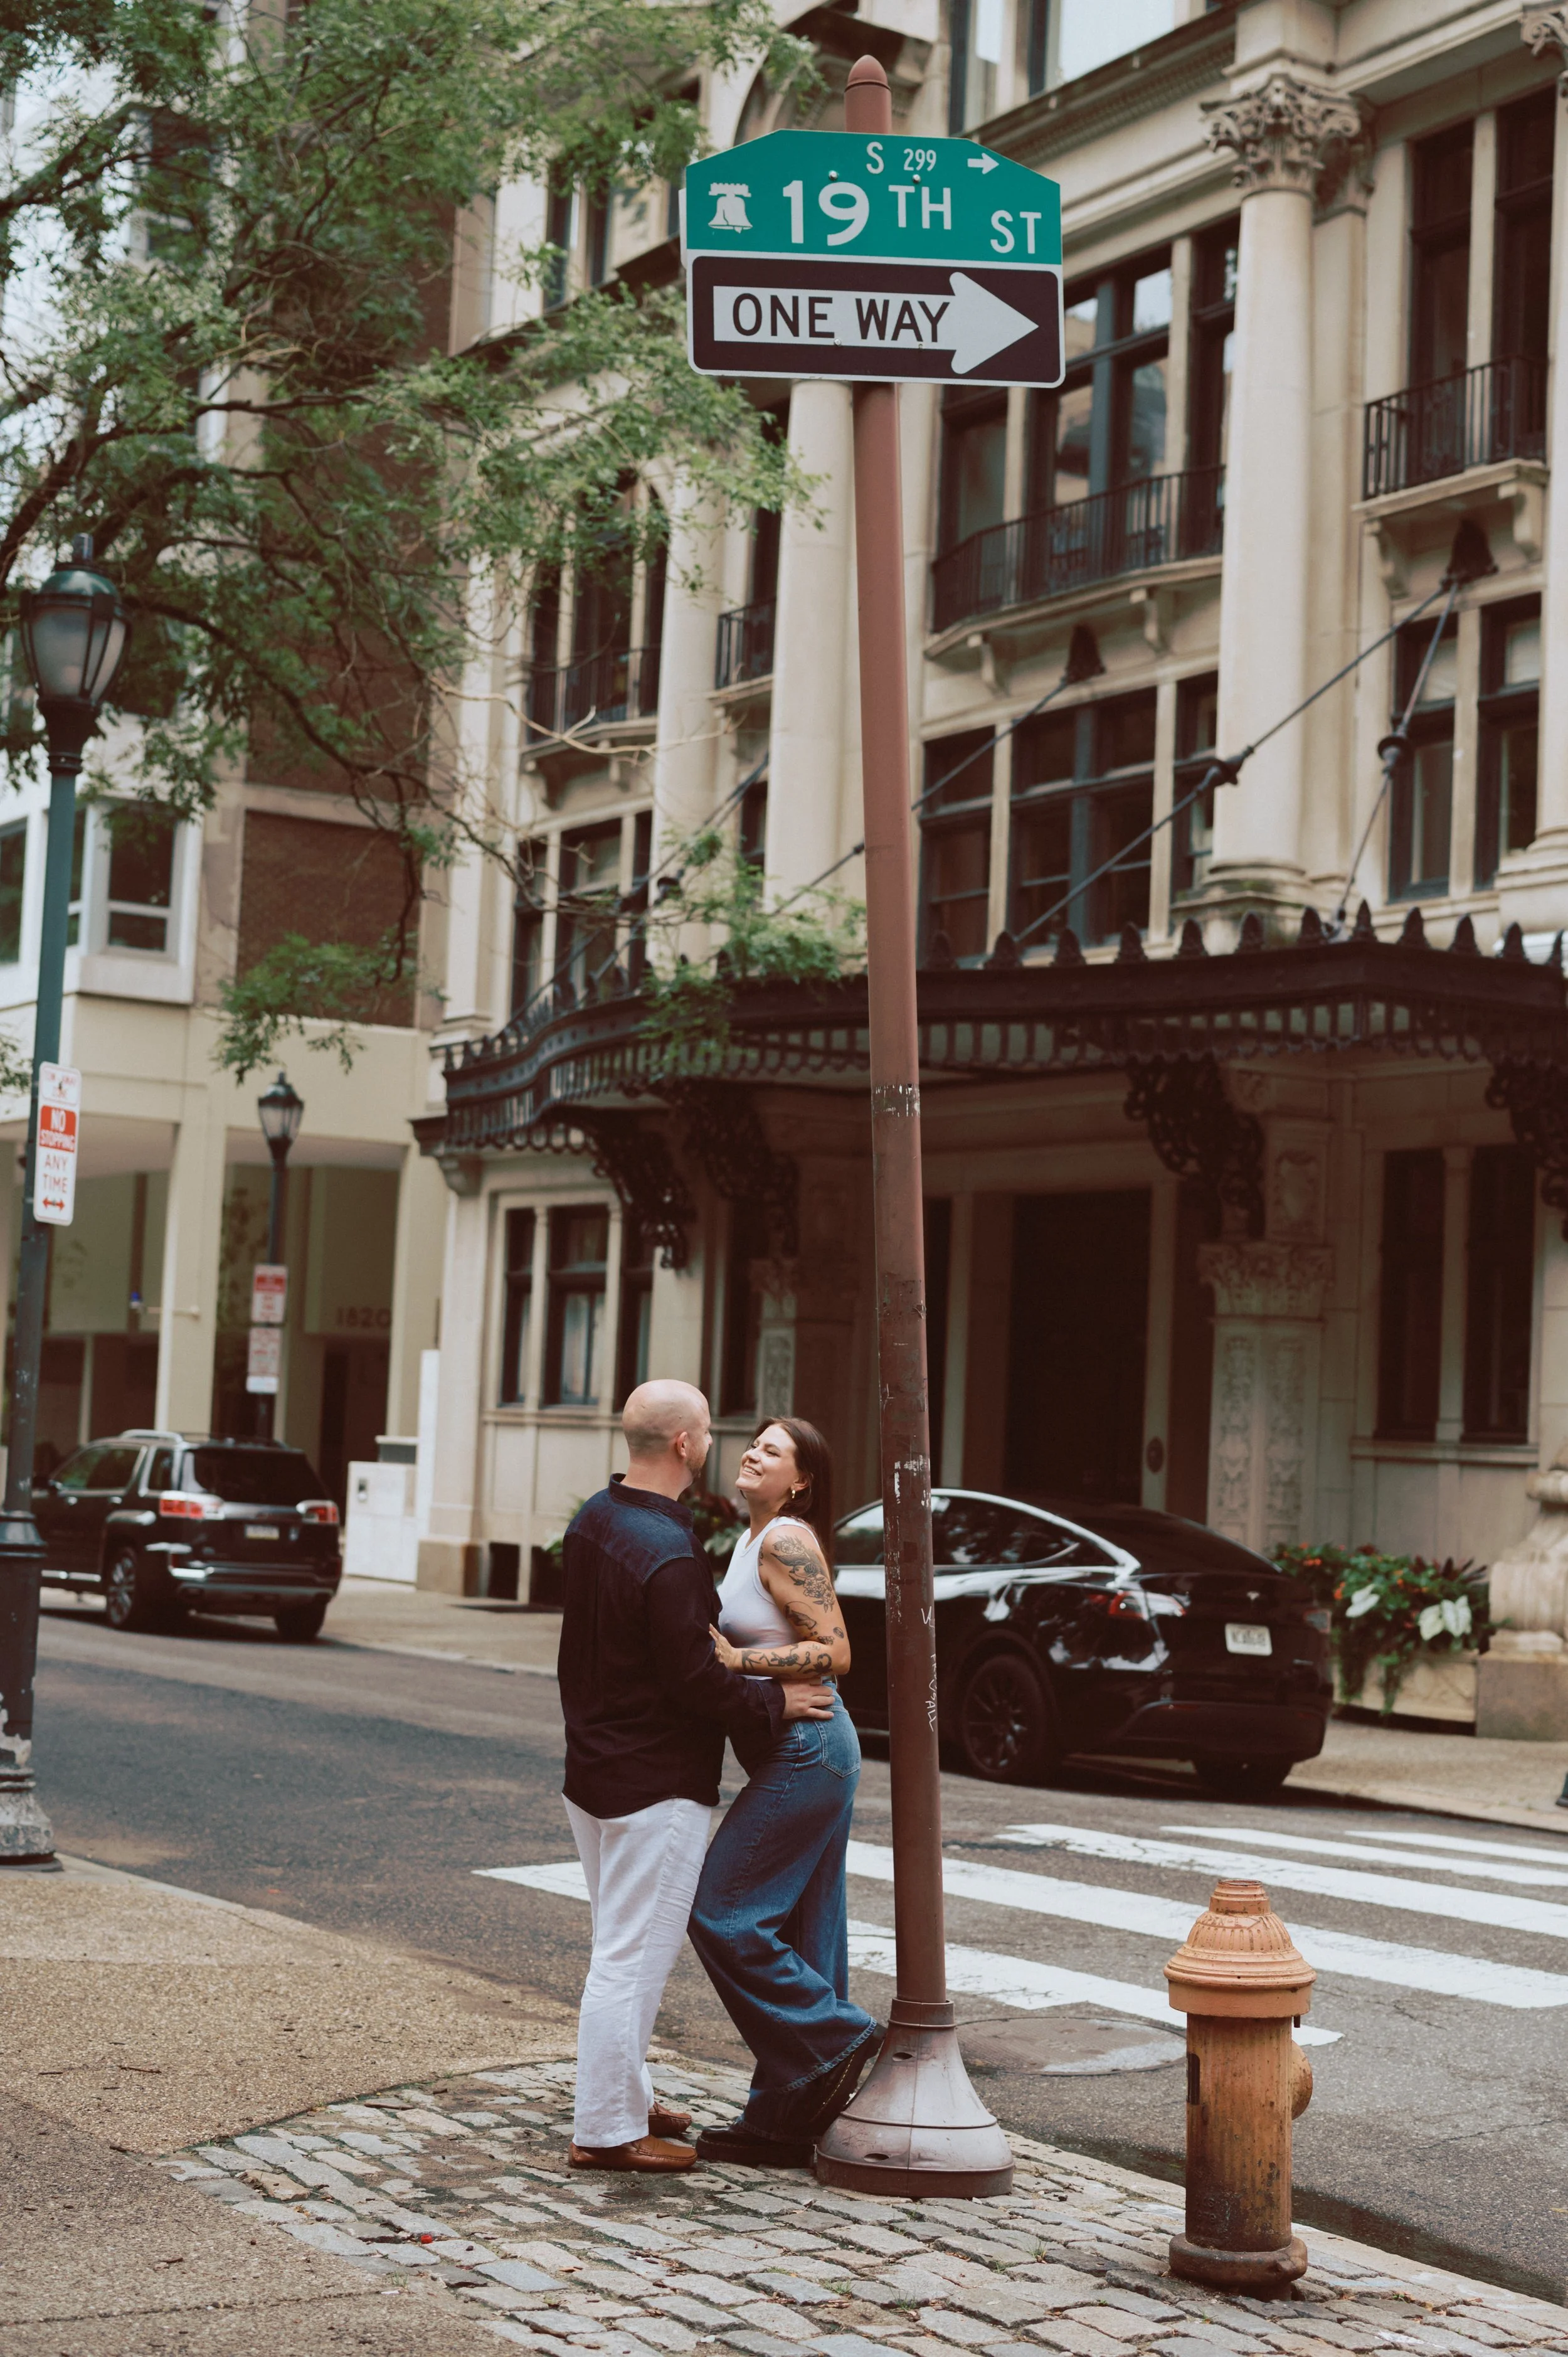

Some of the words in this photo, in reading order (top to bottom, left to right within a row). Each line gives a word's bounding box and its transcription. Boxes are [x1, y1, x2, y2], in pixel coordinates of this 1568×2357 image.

[866, 141, 885, 175] S
[903, 148, 937, 172] 299
[989, 210, 1042, 254] ST
[732, 292, 835, 339] ONE
[855, 298, 951, 343] WAY
[50, 1109, 66, 1133] NO
[40, 1129, 75, 1151] STOPPING
[44, 1154, 68, 1171] ANY
[43, 1174, 68, 1193] TIME
